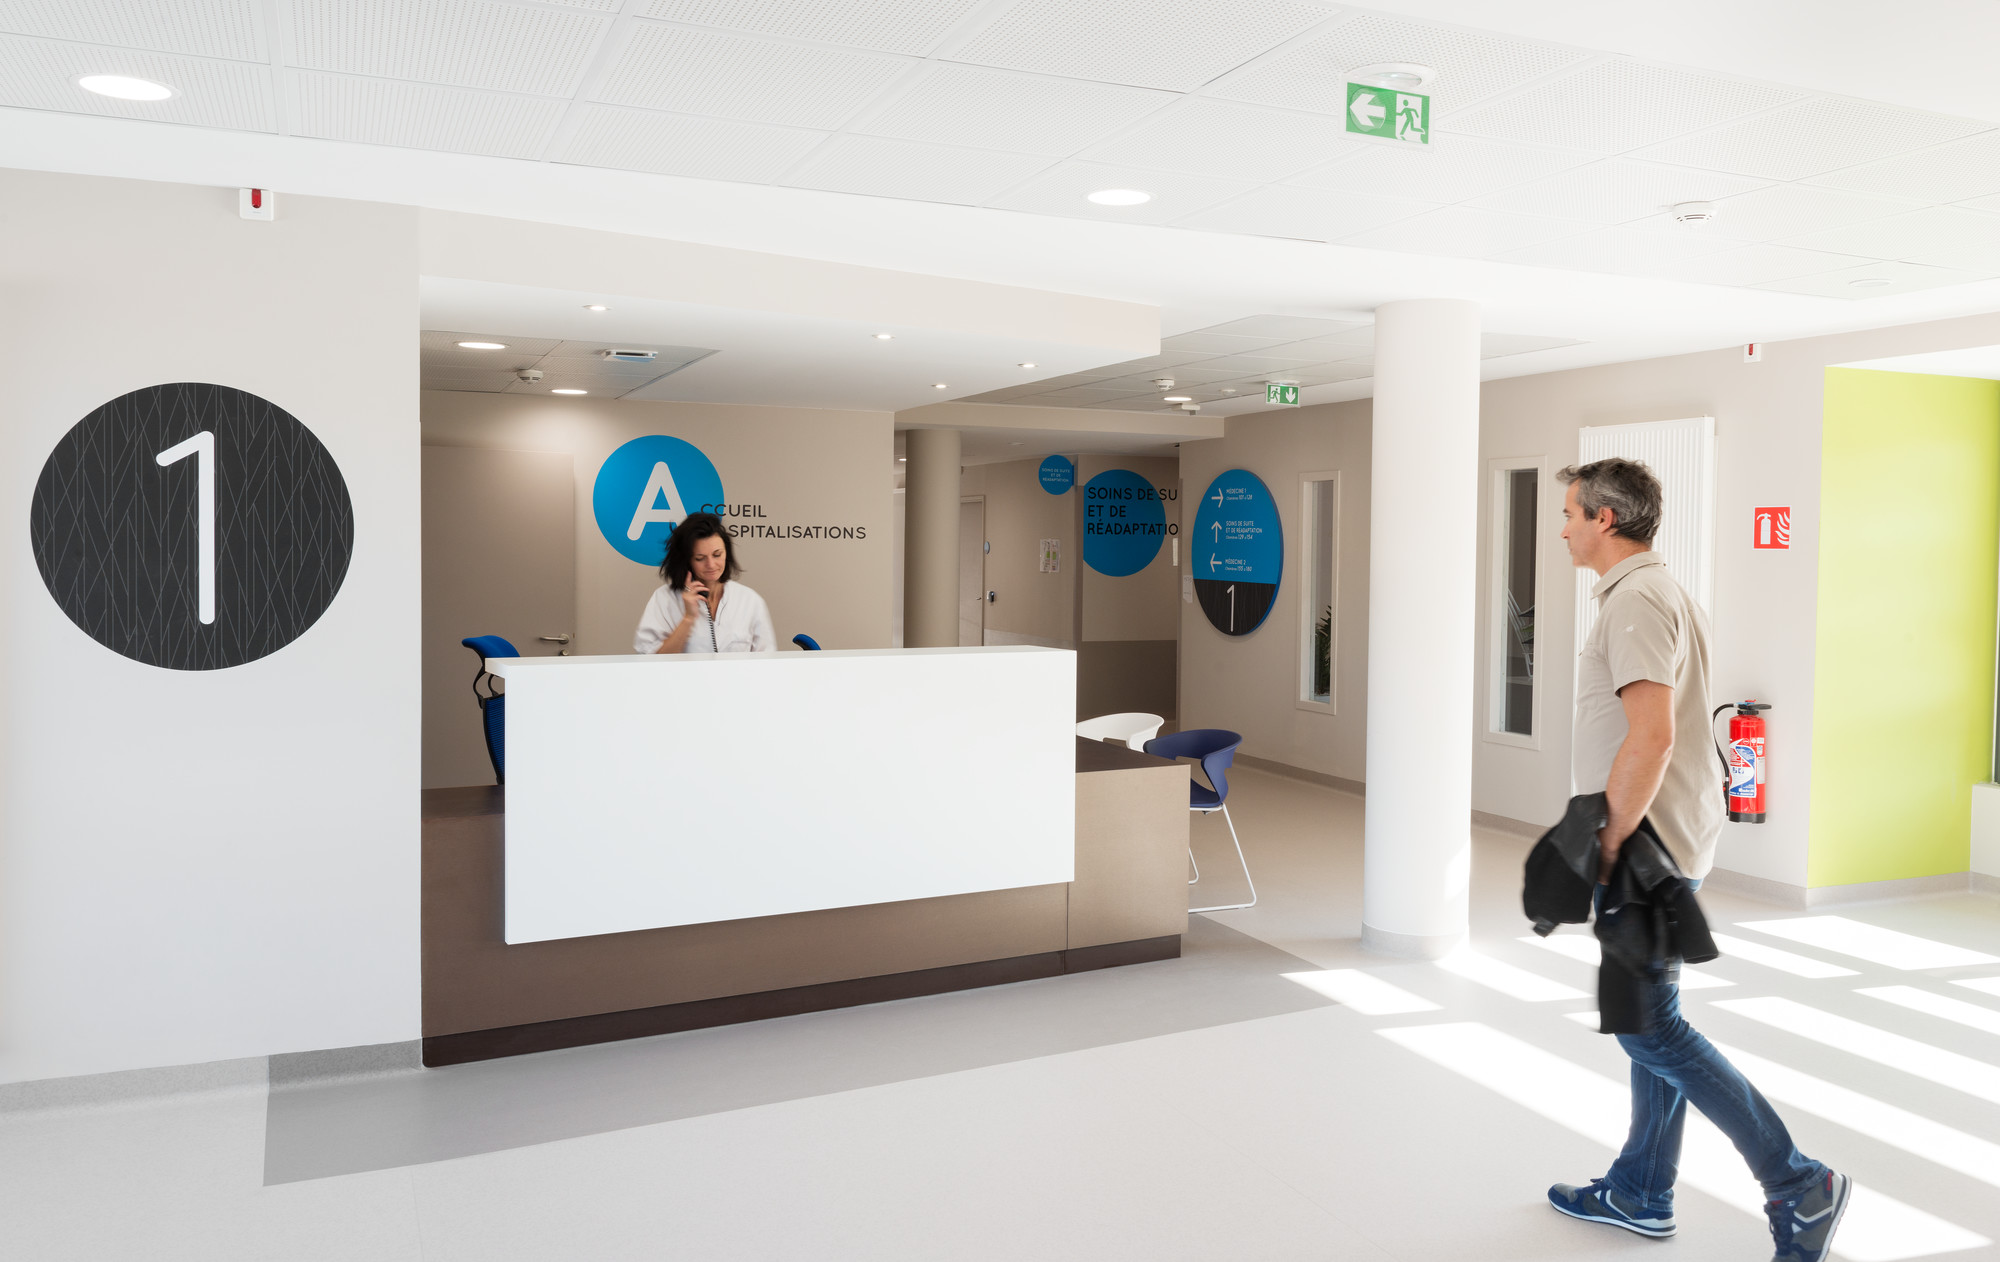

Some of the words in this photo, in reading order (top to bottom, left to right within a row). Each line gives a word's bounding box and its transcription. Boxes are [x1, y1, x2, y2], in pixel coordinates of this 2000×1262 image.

[626, 461, 689, 541] A
[1087, 487, 1133, 501] SOINS
[1137, 488, 1154, 501] DE
[1158, 488, 1178, 501] SU
[1087, 504, 1104, 517] ET
[1109, 505, 1127, 517] DE
[155, 430, 215, 625] 1
[728, 525, 866, 540] SPITALISATIONS
[1087, 518, 1179, 536] RÉADAPTATIO
[1225, 557, 1242, 565] MÉDECINE
[1226, 583, 1235, 633] 1
